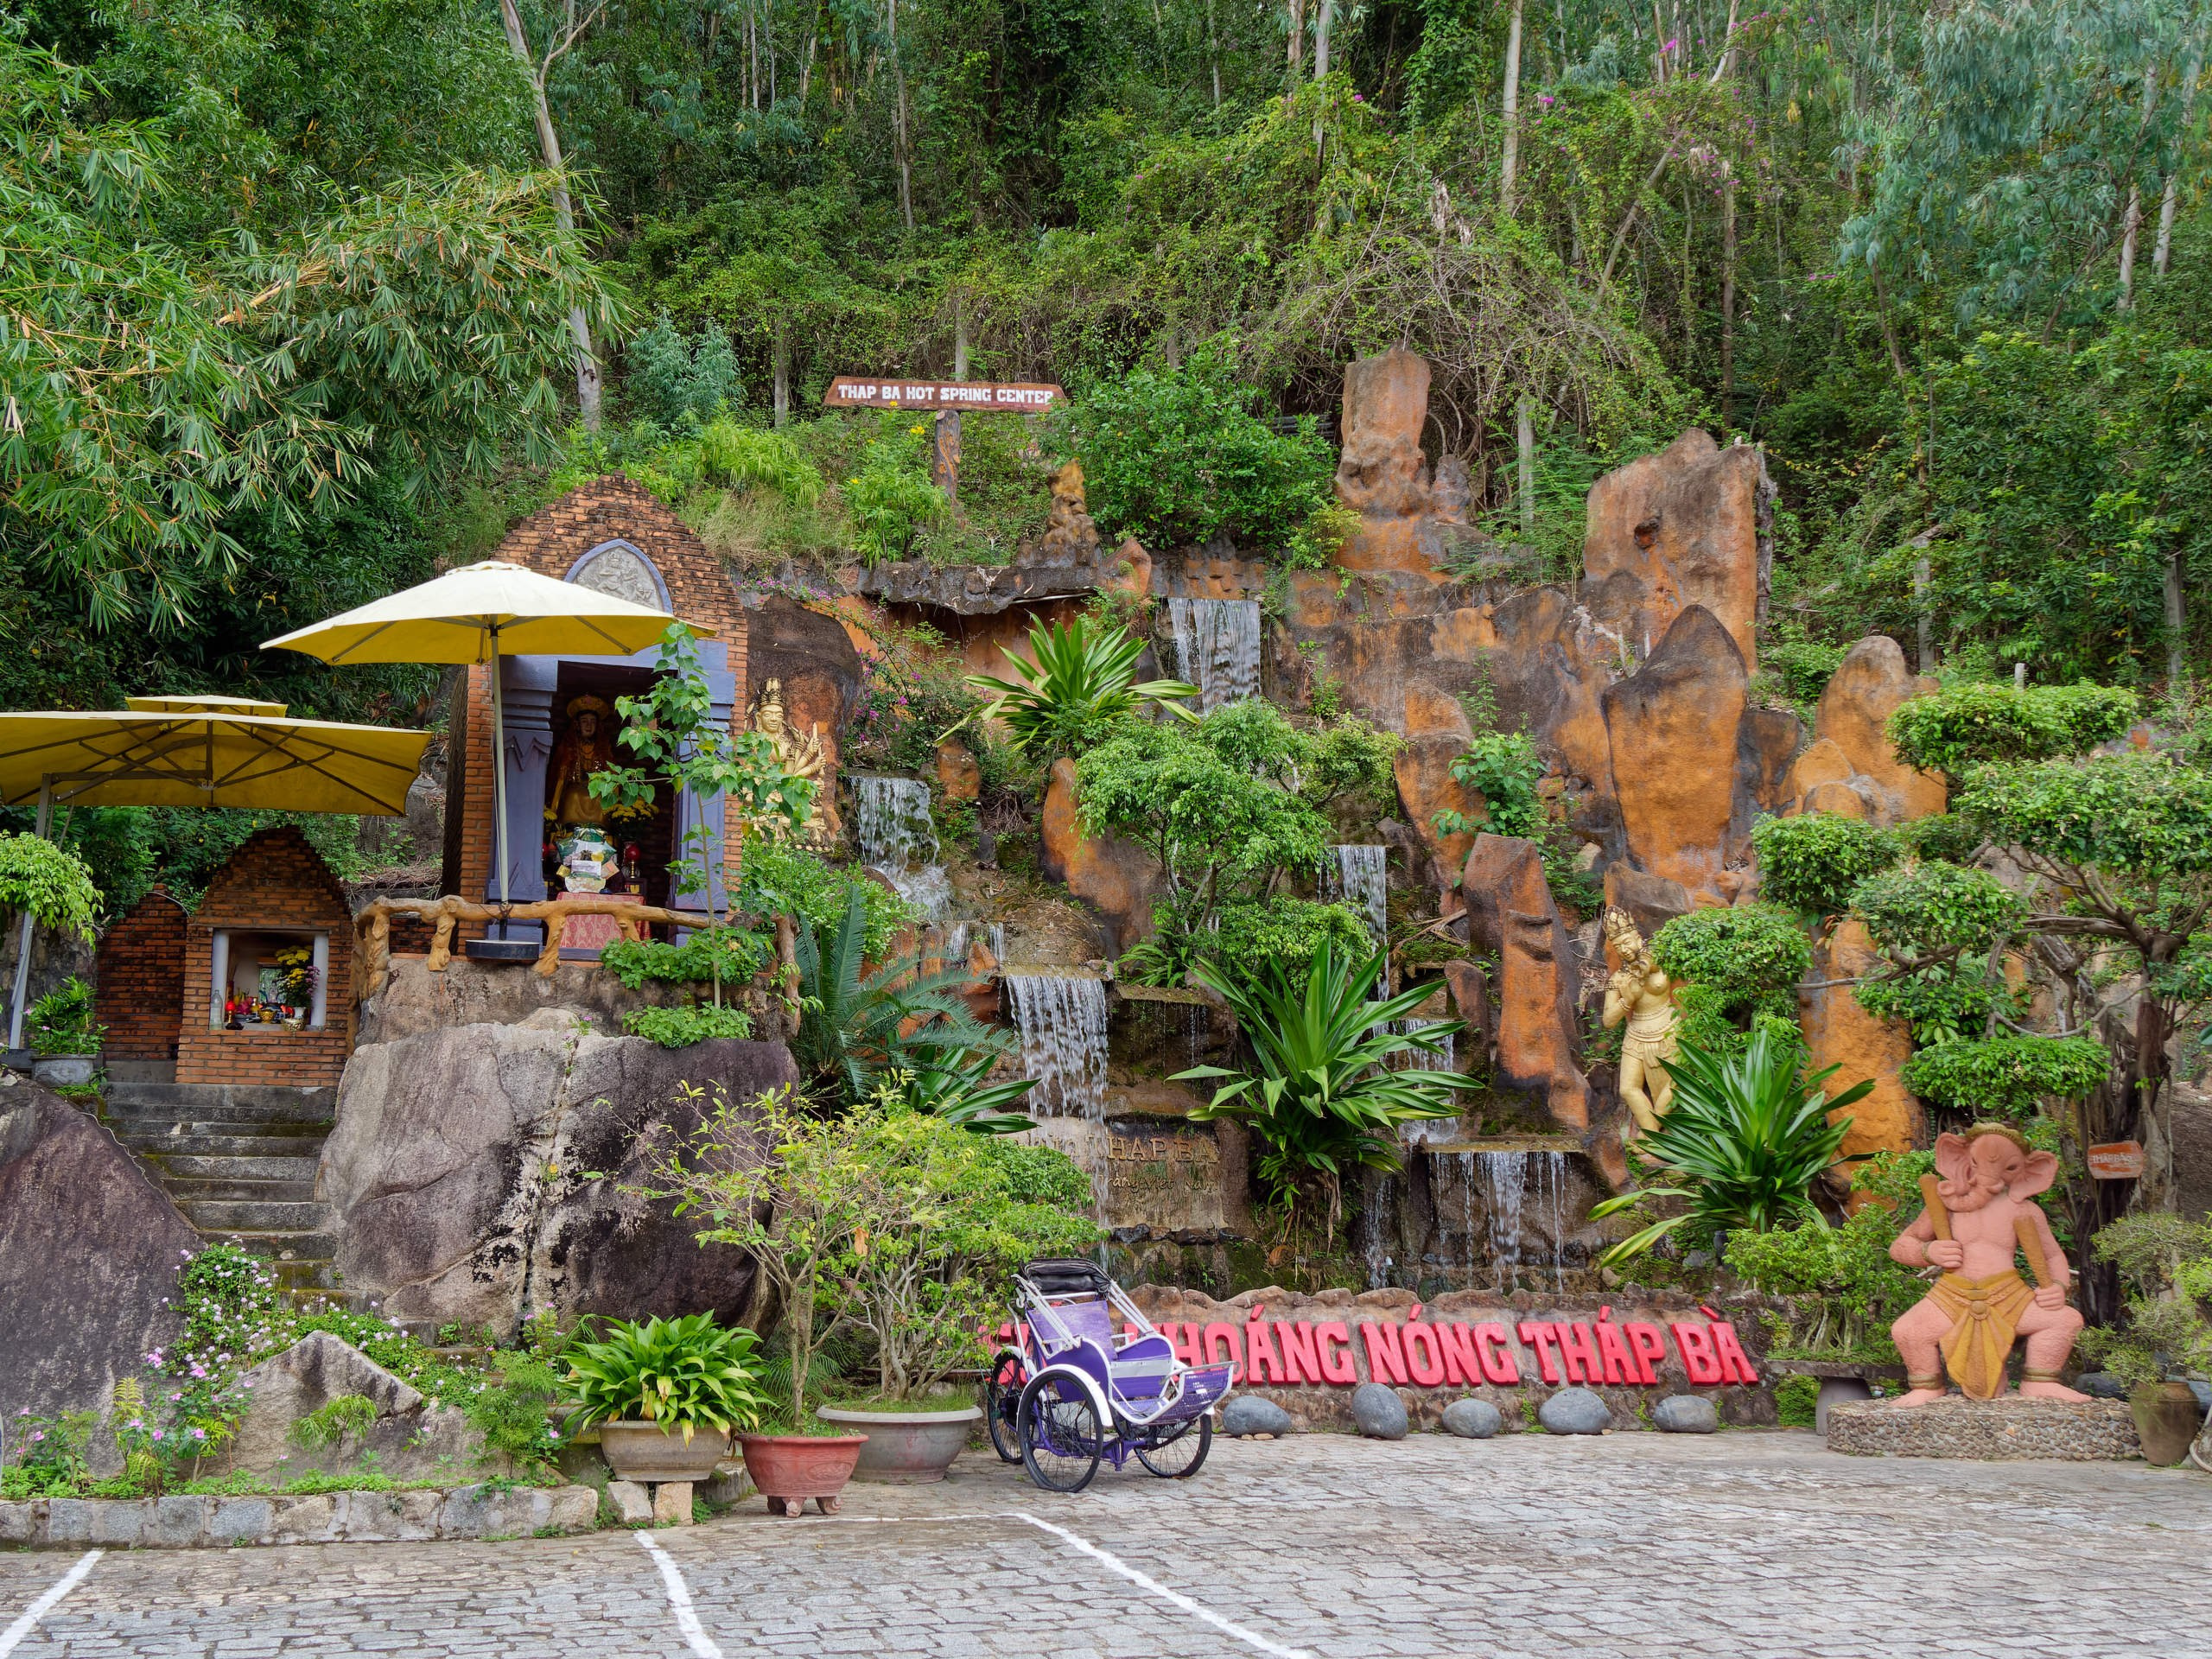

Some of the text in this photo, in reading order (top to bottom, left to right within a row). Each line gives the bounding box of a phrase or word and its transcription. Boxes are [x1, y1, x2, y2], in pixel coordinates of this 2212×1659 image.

[837, 385, 877, 399] THAP
[881, 385, 901, 400] BA
[906, 386, 935, 401] HOT
[939, 387, 992, 402] SPRING
[1360, 1303, 1519, 1388] NÓNG
[1517, 1305, 1666, 1386] THÁP
[1671, 1305, 1759, 1386] BÀ
